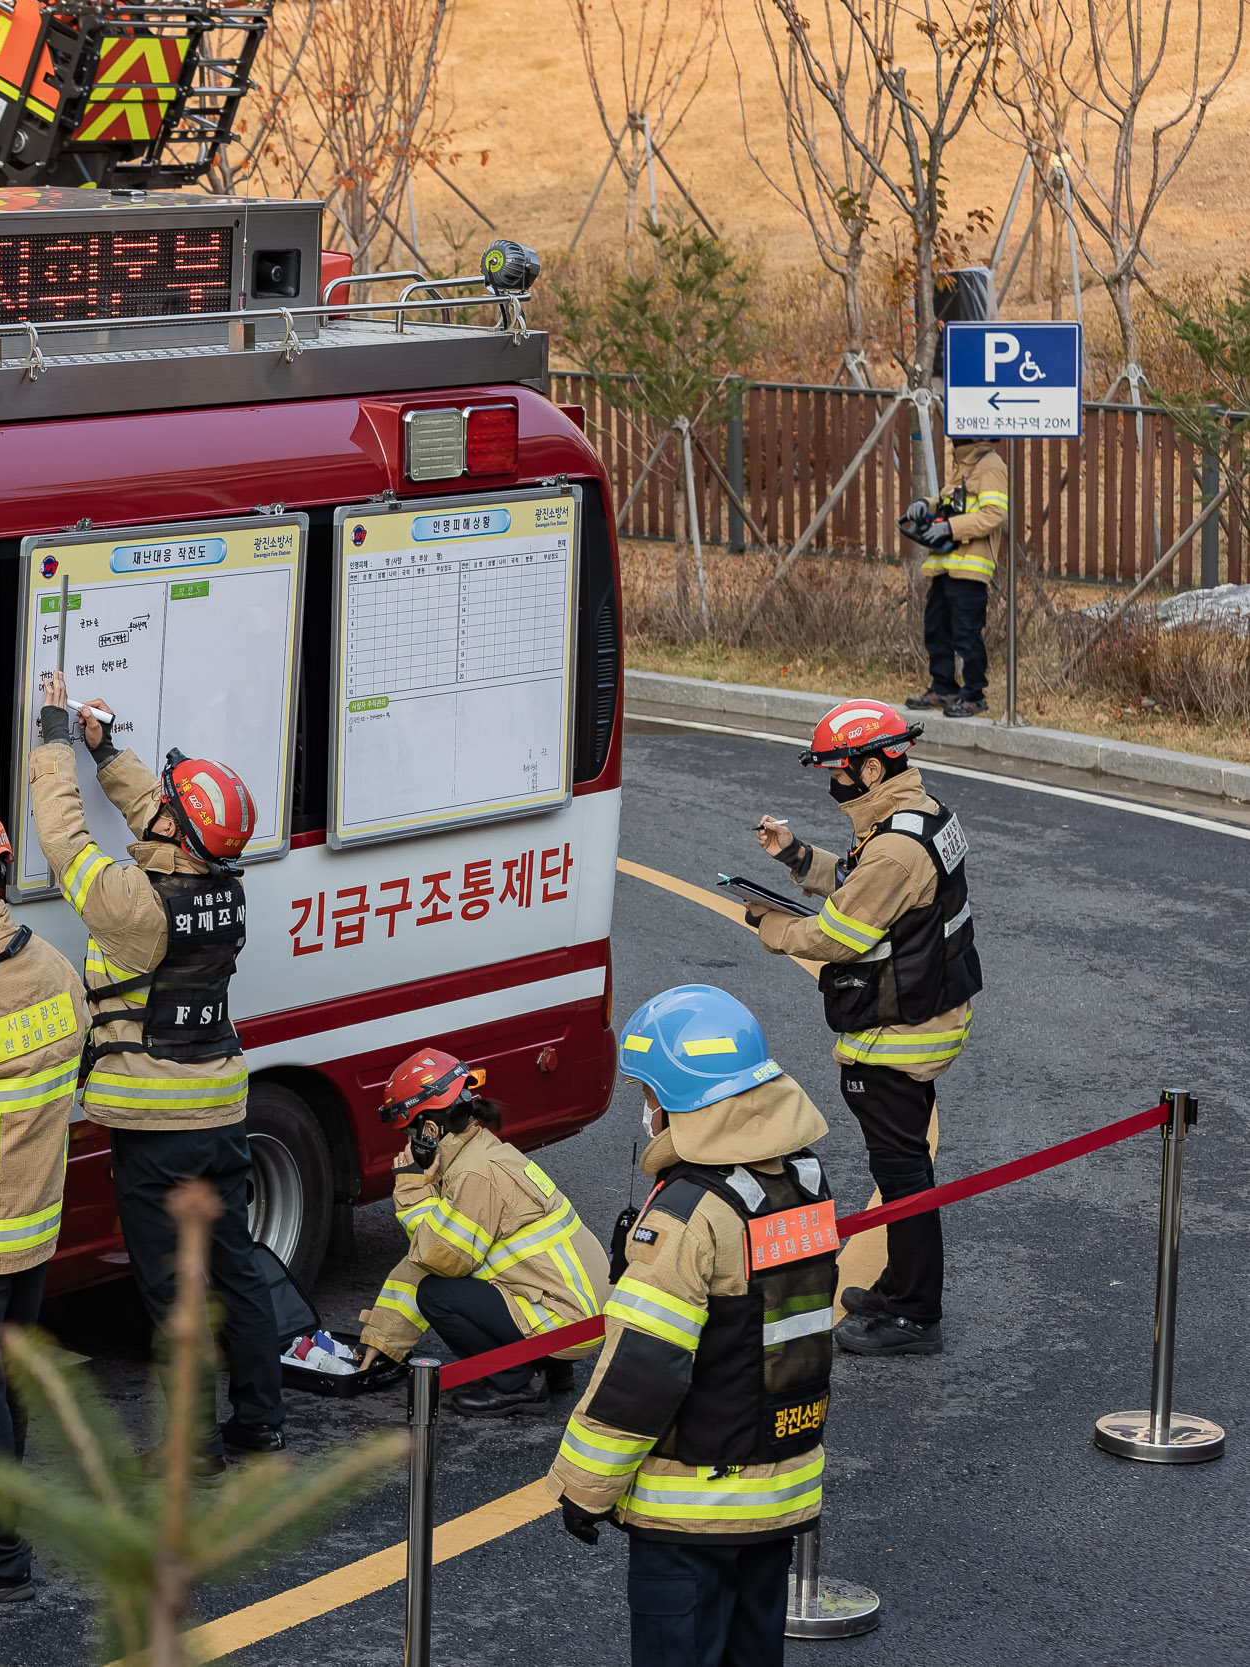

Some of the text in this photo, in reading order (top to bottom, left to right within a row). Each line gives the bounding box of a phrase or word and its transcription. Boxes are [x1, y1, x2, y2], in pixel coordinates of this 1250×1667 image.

[985, 332, 1020, 382] P
[955, 417, 1071, 430] 장애인 주차구역 20M
[534, 506, 569, 520] 광진소방서
[432, 516, 491, 534] 인명피해상황
[253, 534, 293, 551] 광진소방서
[132, 545, 206, 565] 재난대응 작전도
[865, 721, 880, 731] 소방
[830, 732, 845, 742] 서울
[181, 777, 192, 793] 서울
[198, 810, 213, 826] 소방
[193, 891, 232, 907] 서울소방
[289, 842, 574, 957] 긴급구조통제단
[175, 905, 246, 935] 화재조사
[4, 1017, 69, 1055] 현장대응단
[755, 1227, 837, 1264] 현장대응단장
[774, 1395, 829, 1439] 광진소방서
